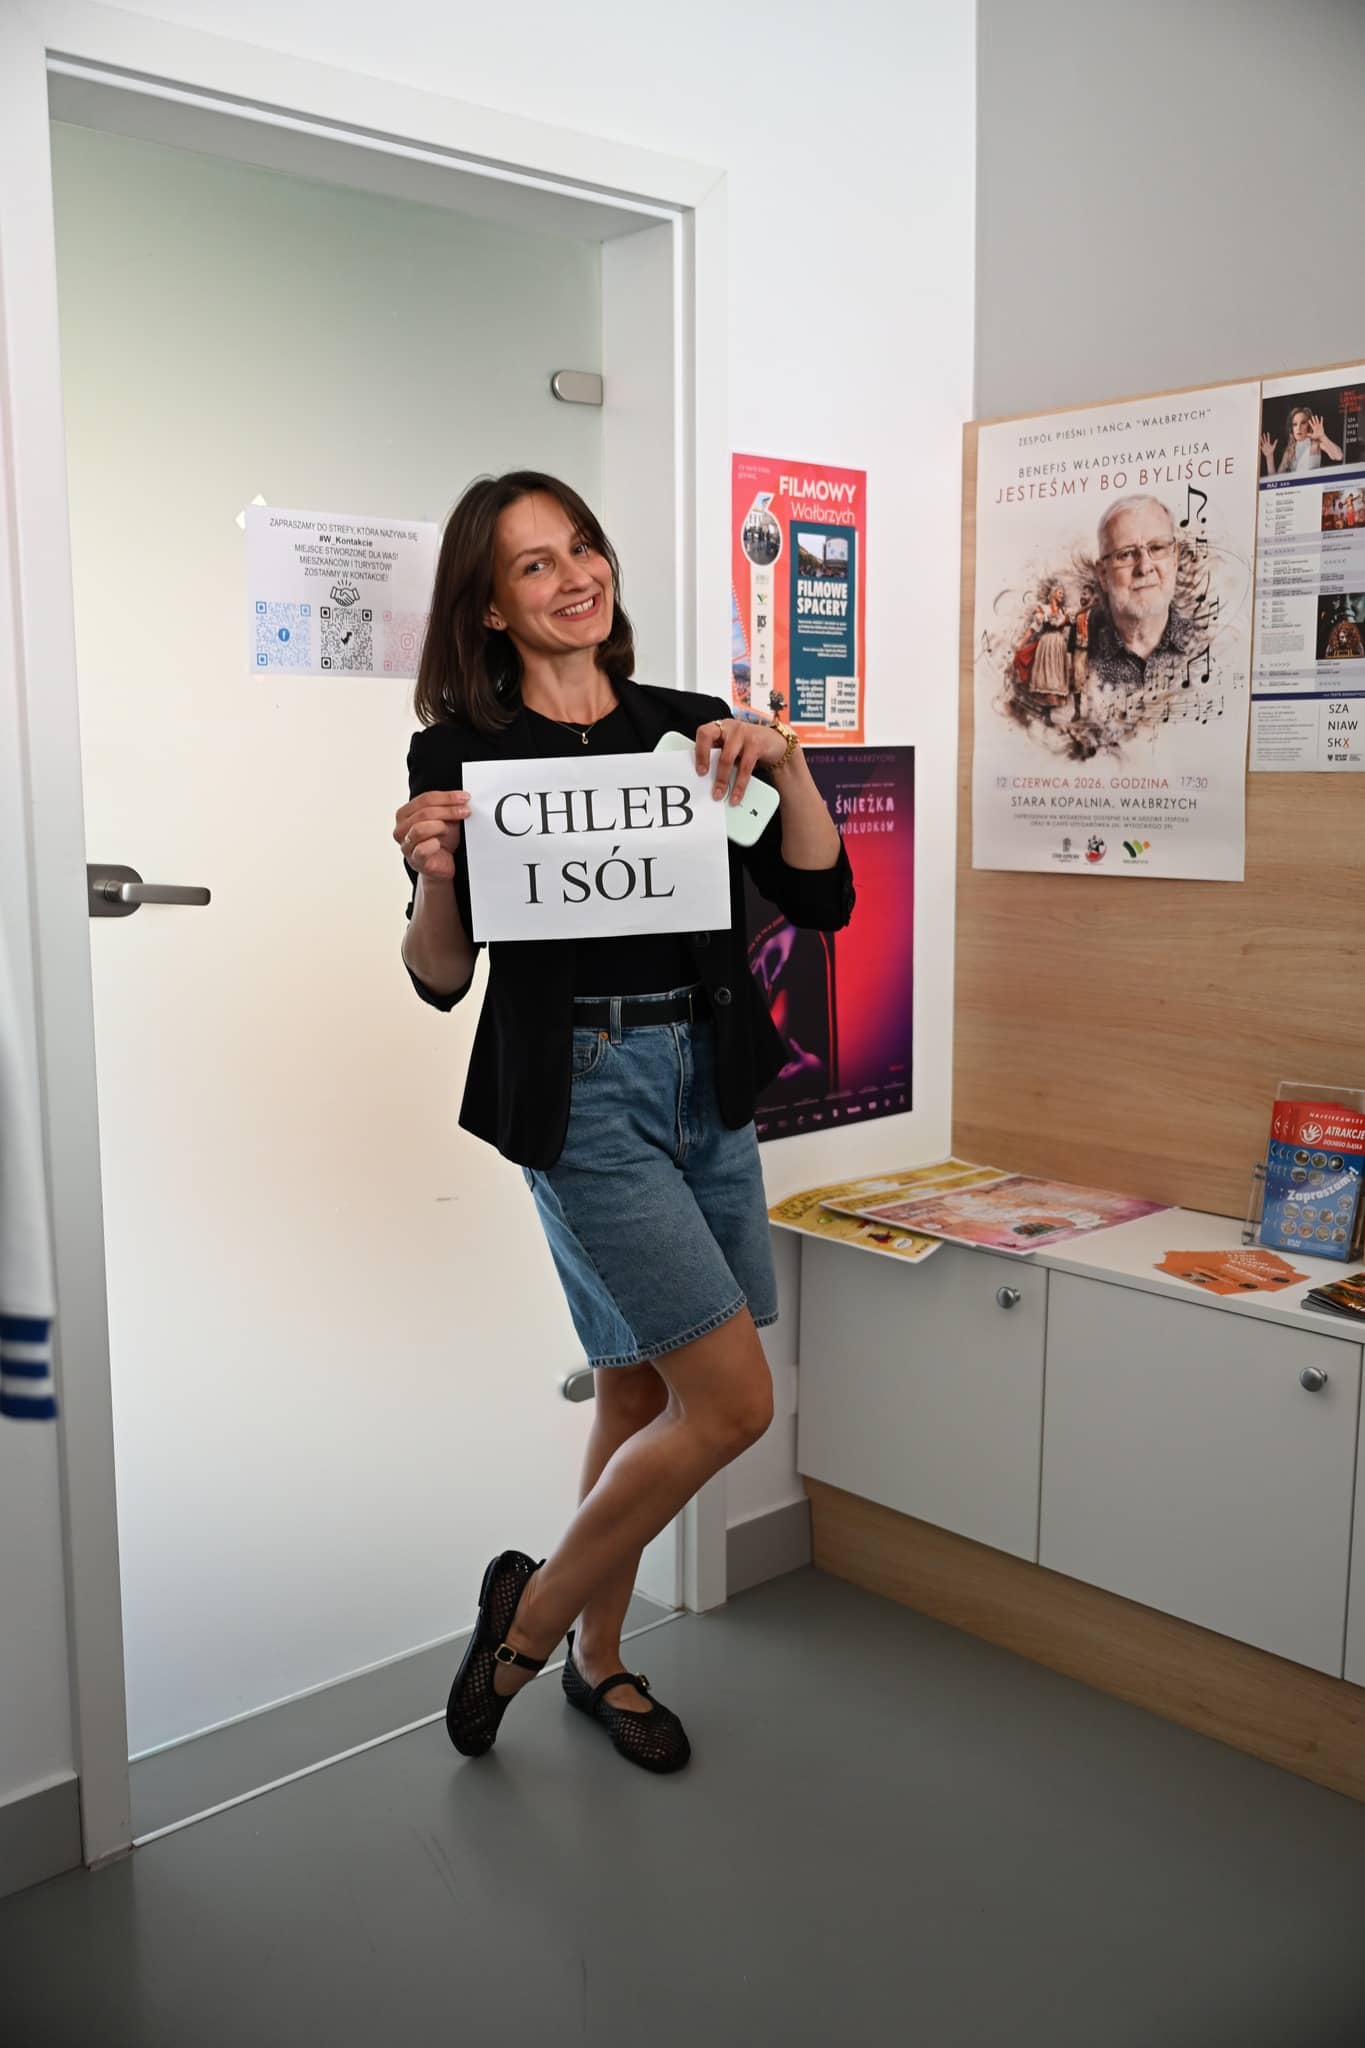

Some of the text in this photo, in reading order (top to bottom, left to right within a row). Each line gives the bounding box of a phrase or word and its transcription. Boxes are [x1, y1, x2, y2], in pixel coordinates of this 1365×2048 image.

[1018, 433, 1052, 447] ZESPÓŁ
[1056, 429, 1087, 441] PIEŚNI
[1097, 421, 1132, 434] TAŃCA
[1018, 442, 1210, 478] BENEFIS WŁADYSŁAWA FLISA
[779, 475, 857, 504] FILMOWY
[995, 458, 1235, 504] JESTEŚMY BO BYLIŚCIE
[791, 501, 856, 526] Wałbrzych
[270, 518, 315, 530] ZAPRASZAMY
[317, 522, 328, 532] DO
[357, 527, 379, 537] KTÓRA
[380, 529, 407, 539] NAZYWA
[320, 535, 373, 547] #W_Kontakcie
[294, 544, 324, 554] MIEJSCE
[325, 546, 368, 558] STWORZONE
[369, 550, 381, 559] DLA
[341, 570, 350, 578] W
[350, 571, 389, 582] KONTAKCIE!
[797, 580, 848, 599] FILMOWE
[797, 598, 848, 617] SPACERY
[1328, 704, 1349, 714] SZA
[1328, 721, 1358, 731] NIAW
[1013, 777, 1069, 789] CZERWCA
[1110, 778, 1169, 789] GODZINA
[1181, 776, 1208, 789] 17:30
[494, 785, 694, 837] CHLEB
[836, 794, 895, 815] ŚNIEŻKA
[1011, 796, 1046, 808] STARA
[1120, 798, 1197, 810] WAŁBRZYCH
[523, 845, 675, 904] I SÓL
[1309, 1112, 1364, 1124] NAJCIEKAWSZE
[1324, 1125, 1365, 1141] ATRAKCJE
